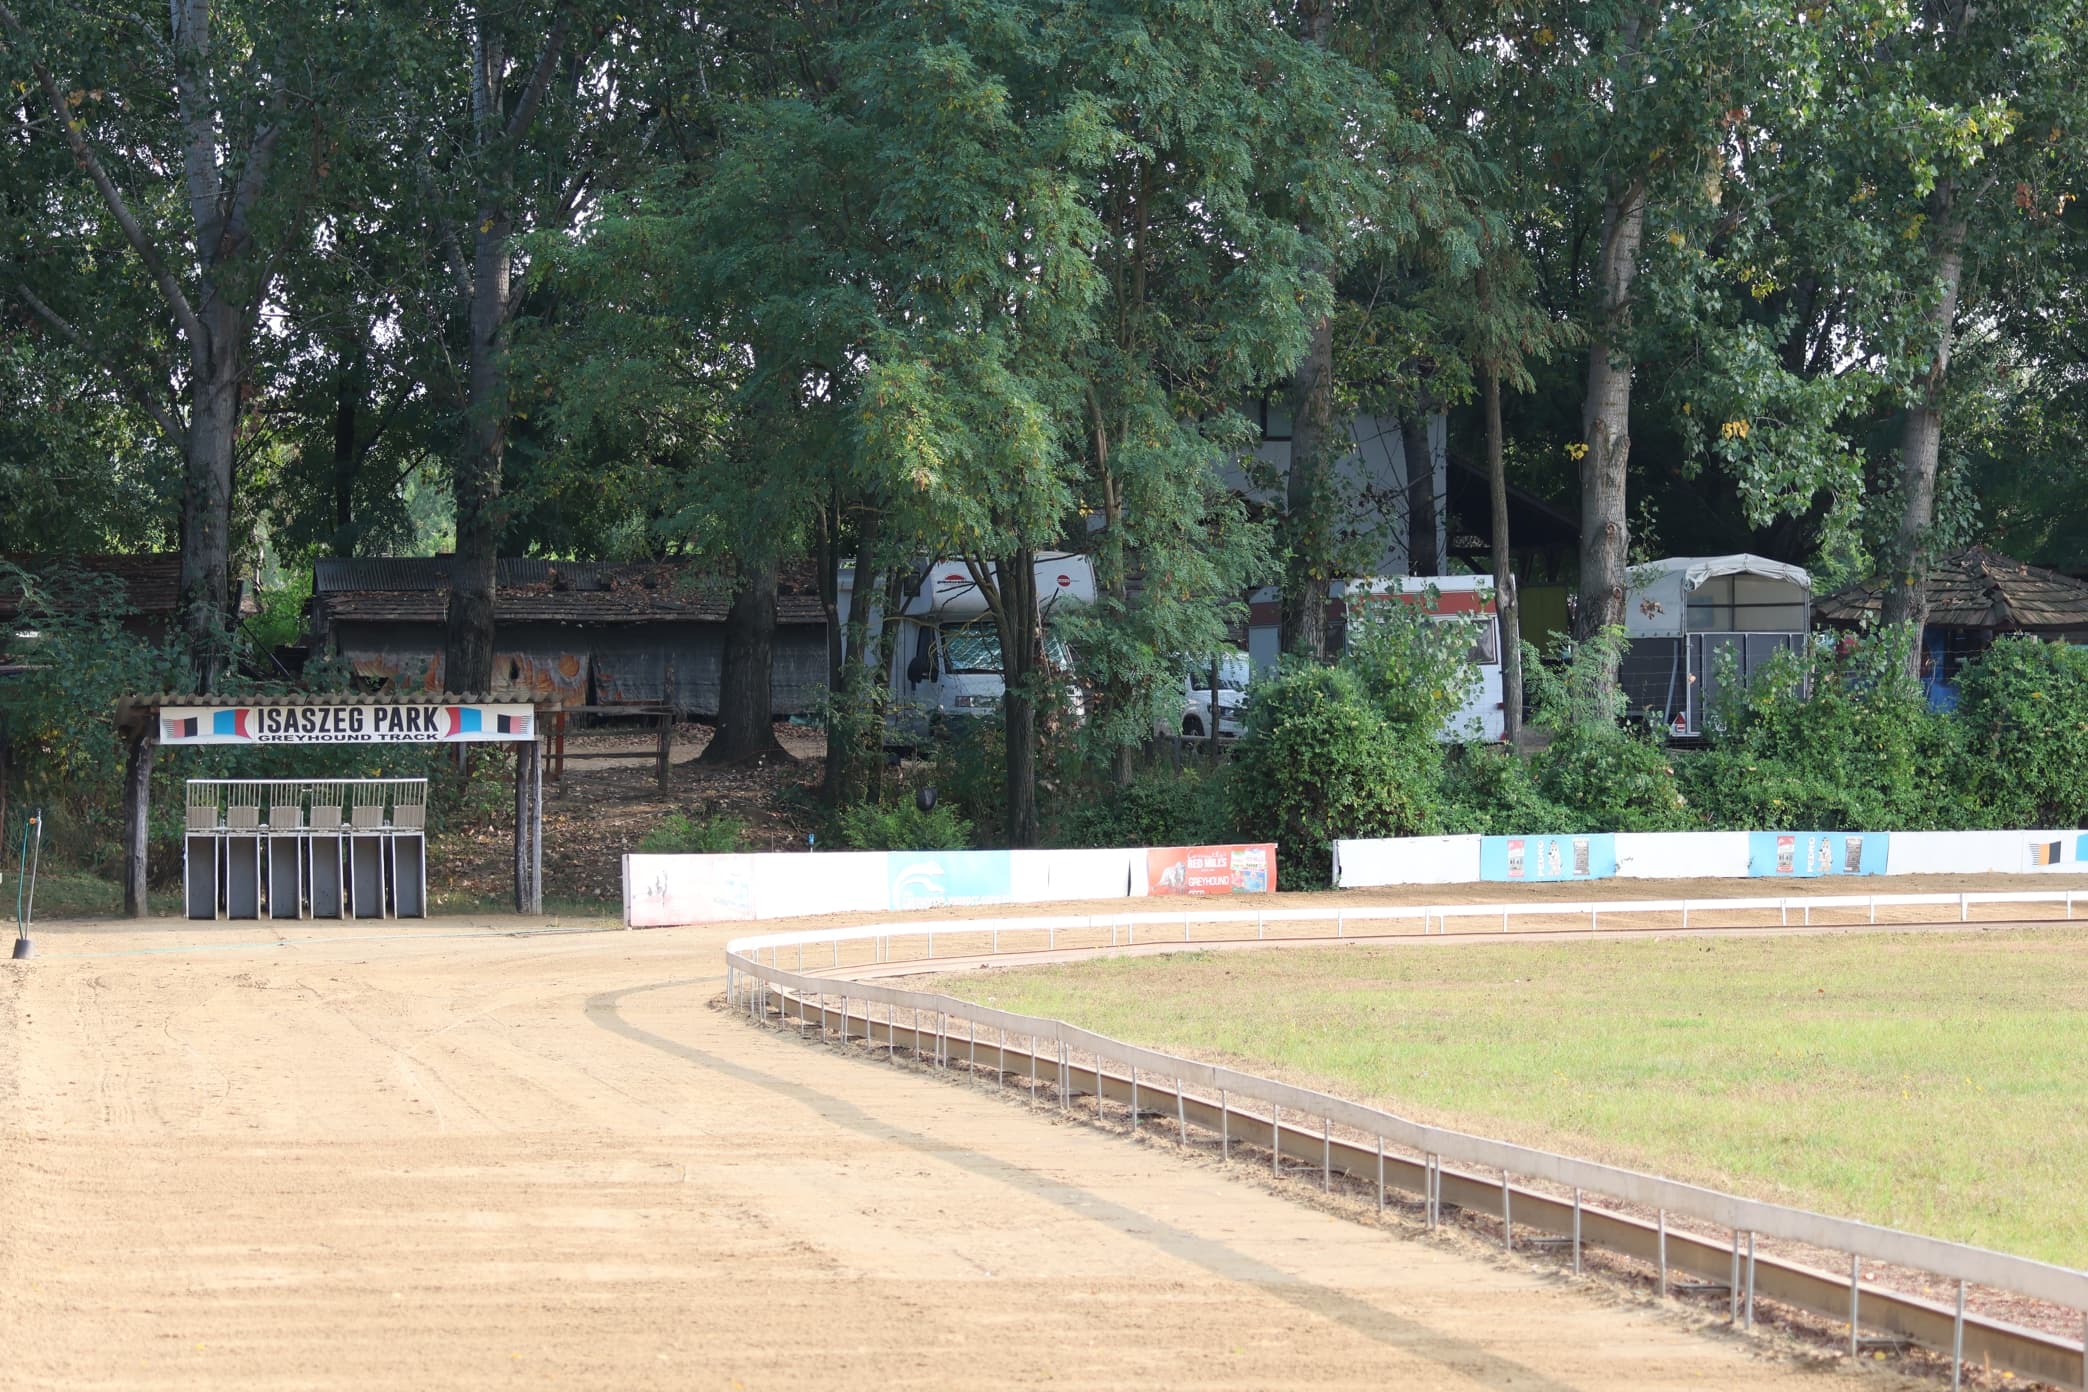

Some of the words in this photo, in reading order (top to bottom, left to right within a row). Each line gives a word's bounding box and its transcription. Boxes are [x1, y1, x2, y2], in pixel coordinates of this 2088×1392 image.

[258, 707, 363, 733] ISASZEG
[374, 706, 439, 732] PARK
[258, 734, 372, 742] GREYHOUND
[378, 733, 438, 741] TRACK
[1188, 858, 1203, 868] RED
[1188, 876, 1229, 886] GREYHOUND
